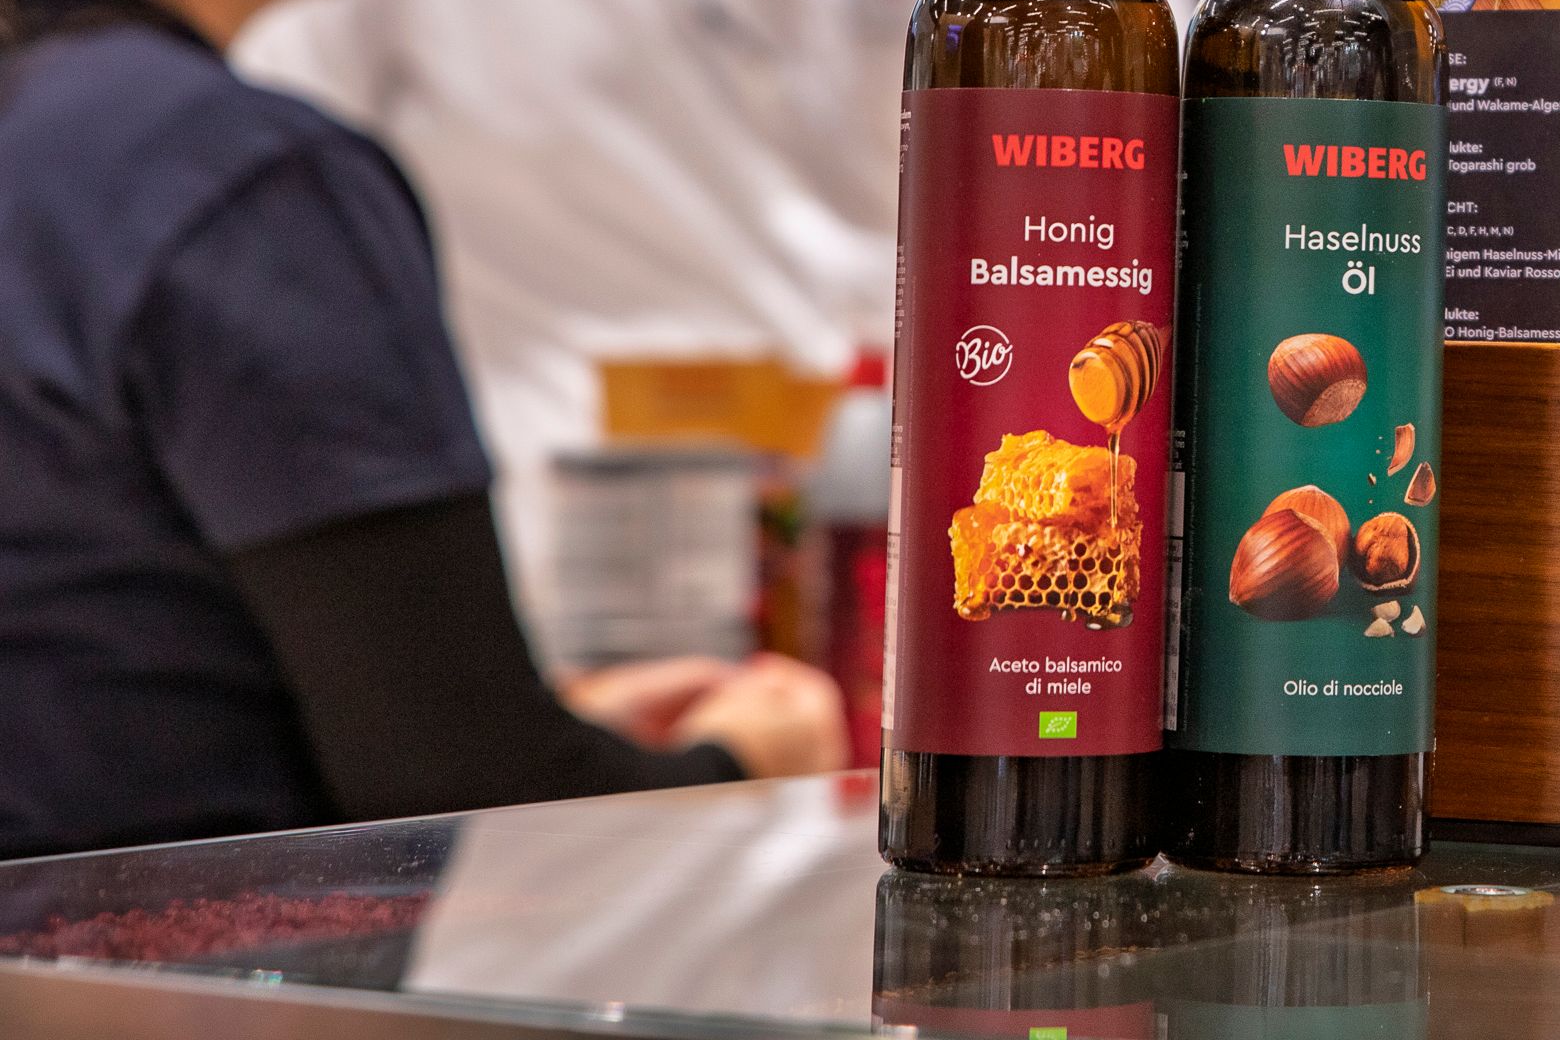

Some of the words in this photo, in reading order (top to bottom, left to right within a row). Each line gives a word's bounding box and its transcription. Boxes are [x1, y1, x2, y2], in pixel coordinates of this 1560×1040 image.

[1449, 77, 1490, 94] ergy
[1452, 99, 1475, 111] und
[992, 133, 1146, 172] WIBERG
[1282, 143, 1428, 182] WIBERG
[1506, 158, 1537, 174] grob
[1024, 215, 1116, 251] Honig
[1284, 223, 1422, 254] Haselnuss
[970, 256, 1153, 296] Balsamessig
[1341, 260, 1376, 296] Öl
[1458, 266, 1481, 278] und
[1484, 266, 1522, 278] Kaviar
[956, 337, 1014, 380] Bio
[989, 657, 1040, 674] Aceto
[1045, 656, 1122, 674] balsamico
[1025, 677, 1042, 695] di
[1047, 677, 1091, 695] miele
[1283, 679, 1318, 697] Olio
[1322, 679, 1339, 697] di
[1343, 679, 1403, 697] nocciole
